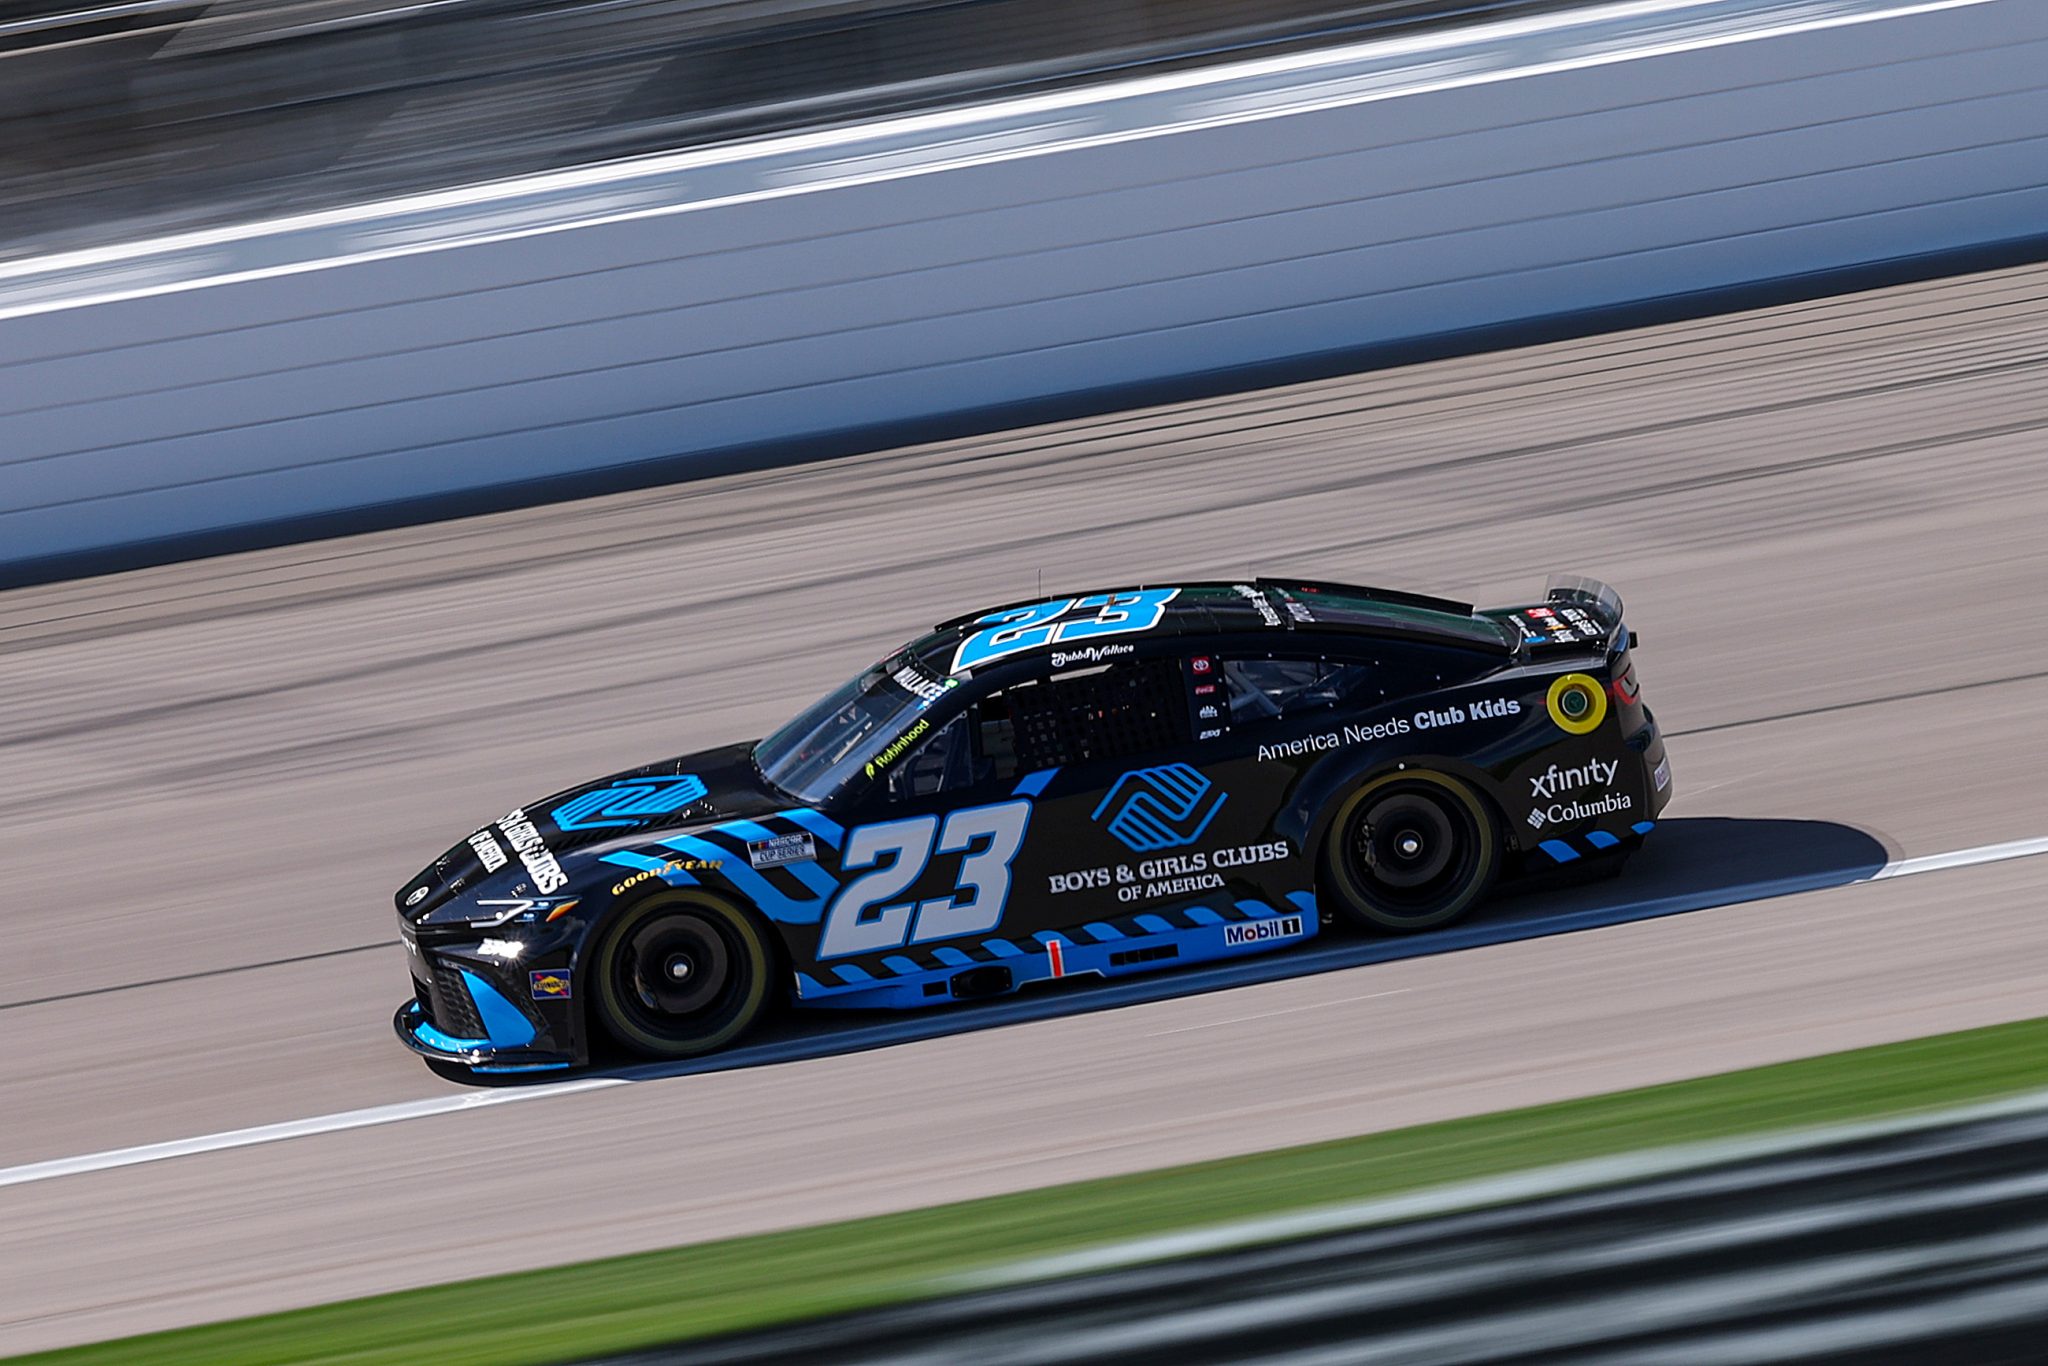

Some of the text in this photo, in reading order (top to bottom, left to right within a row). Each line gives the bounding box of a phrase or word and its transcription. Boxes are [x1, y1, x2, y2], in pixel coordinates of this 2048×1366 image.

[950, 588, 1182, 674] 23
[1087, 644, 1134, 661] Wallace
[875, 718, 930, 768] Robinhood
[1257, 698, 1521, 762] America Needs Club Kids
[1529, 758, 1619, 799] xfinity
[1547, 793, 1632, 823] Columbia
[611, 859, 724, 896] GOODYEAR
[816, 799, 1033, 961] 23
[1049, 841, 1289, 894] BOYS & GIRLS CLUBS
[1117, 873, 1225, 902] OF AMERICA
[1226, 921, 1281, 945] Mobil
